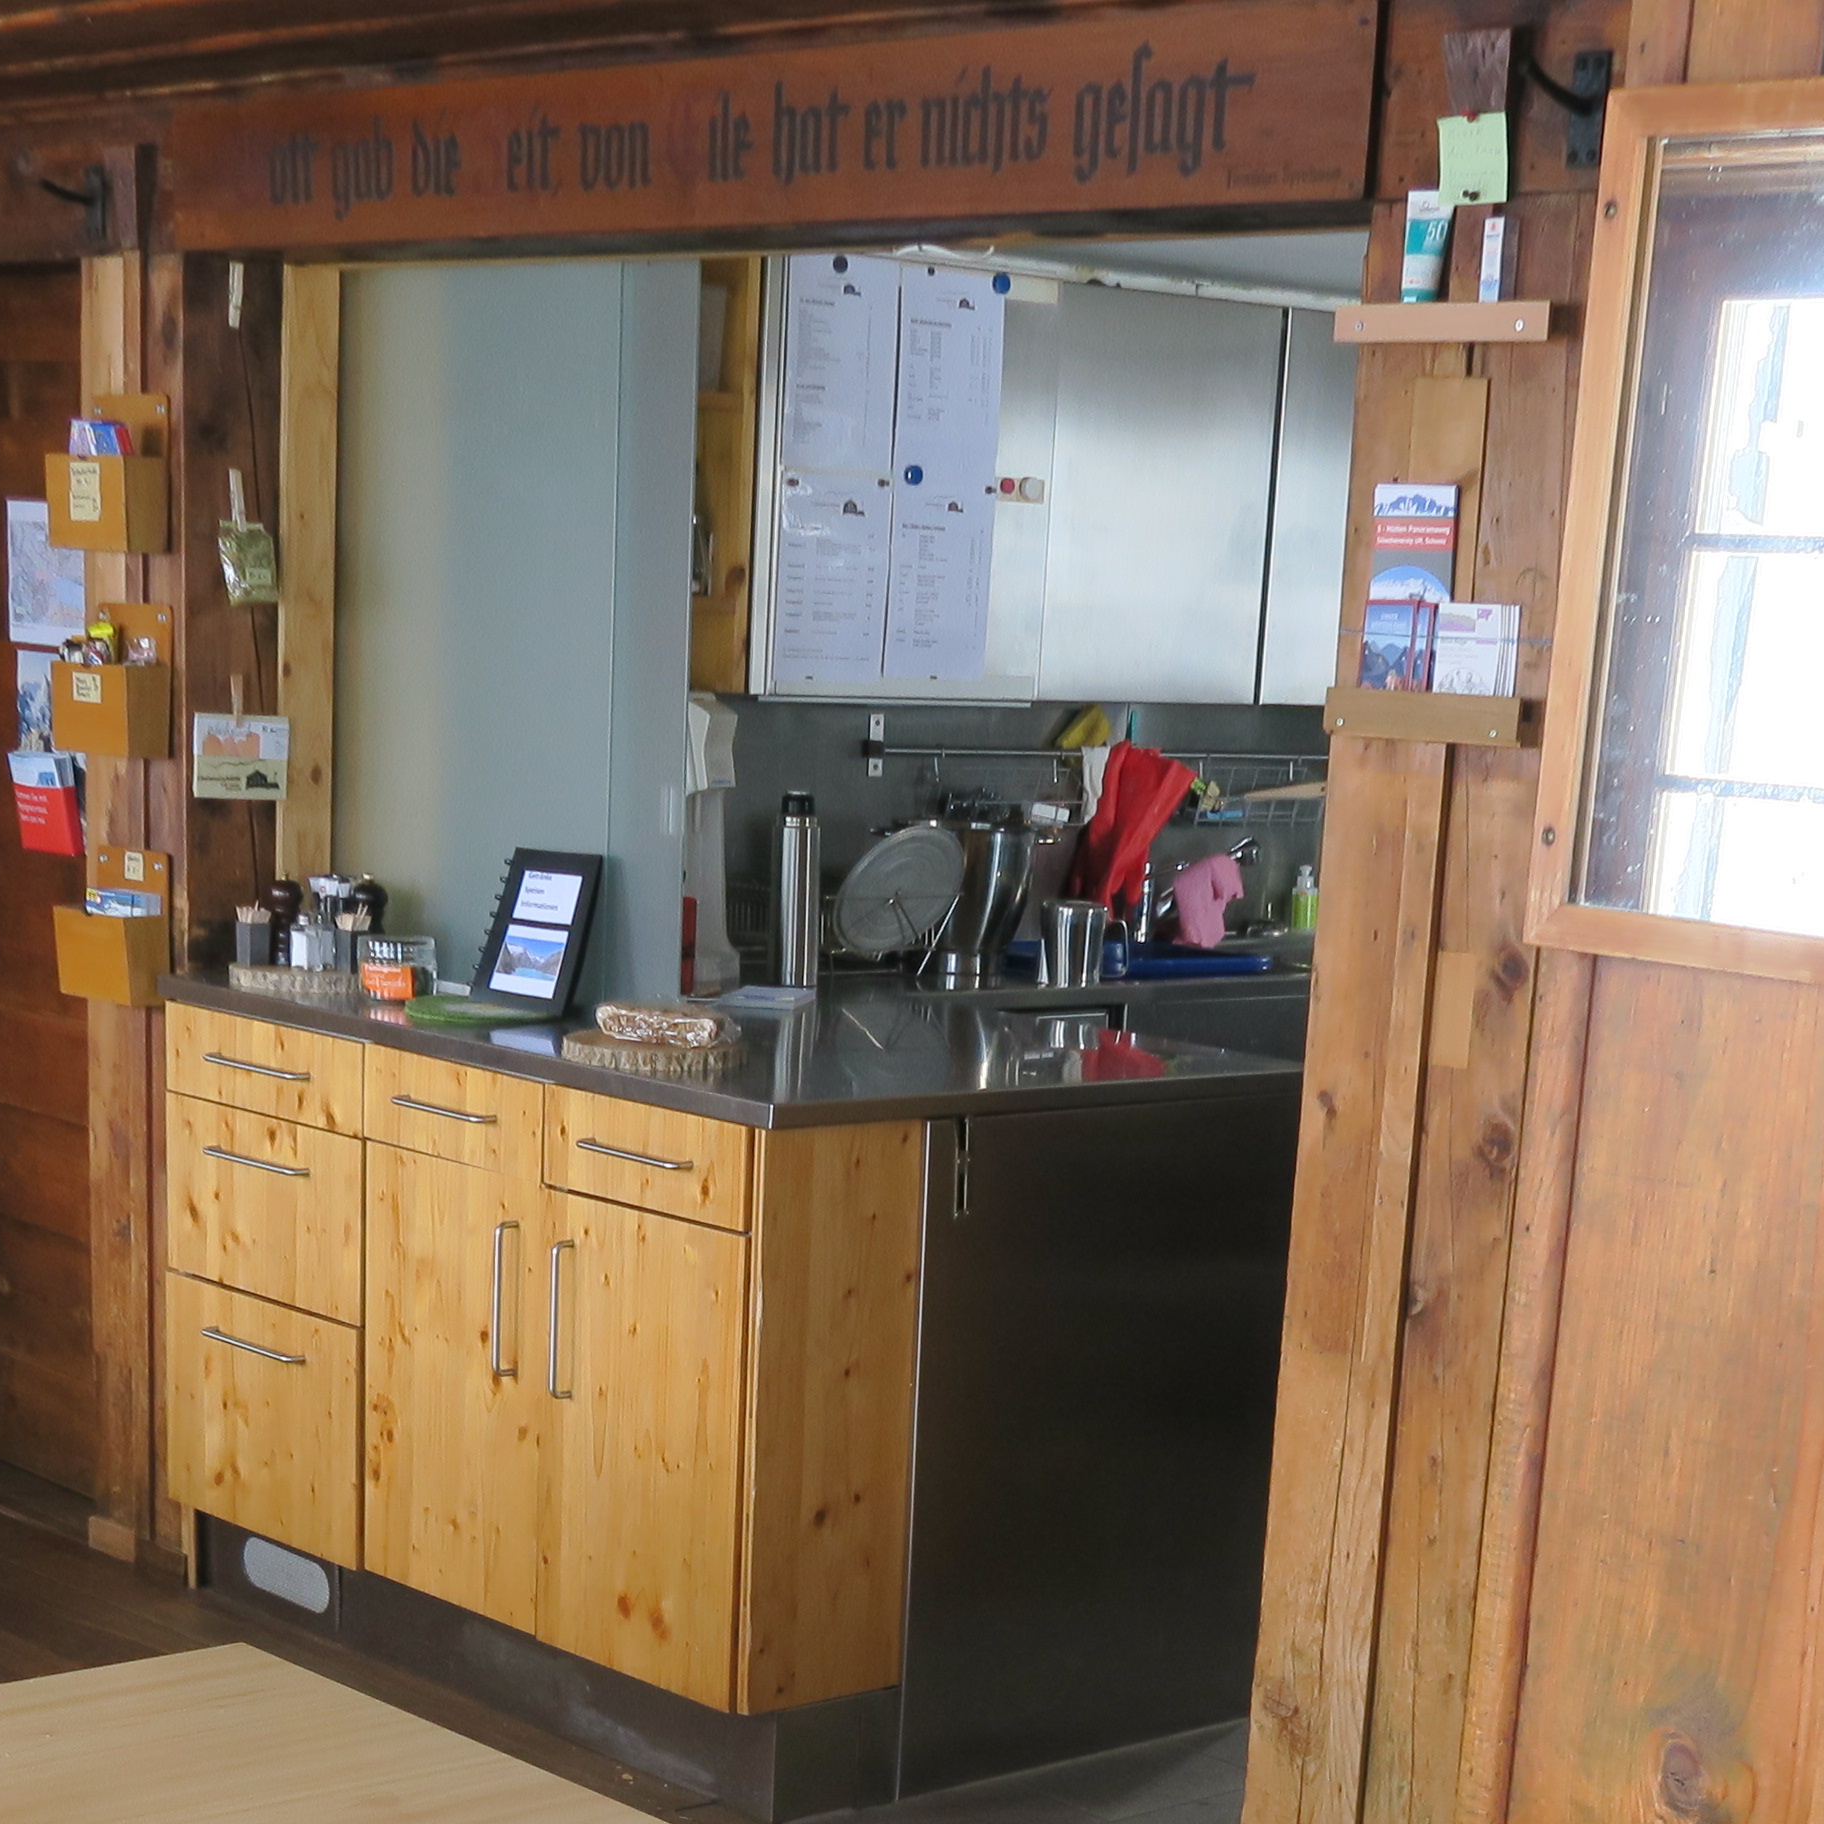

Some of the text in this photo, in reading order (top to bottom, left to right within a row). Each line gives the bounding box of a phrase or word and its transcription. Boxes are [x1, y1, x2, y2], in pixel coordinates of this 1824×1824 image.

[411, 107, 462, 197] die
[579, 120, 652, 192] von
[772, 79, 853, 188] hat
[863, 97, 908, 172] er
[920, 64, 1052, 177] nichts
[1426, 220, 1448, 241] 50
